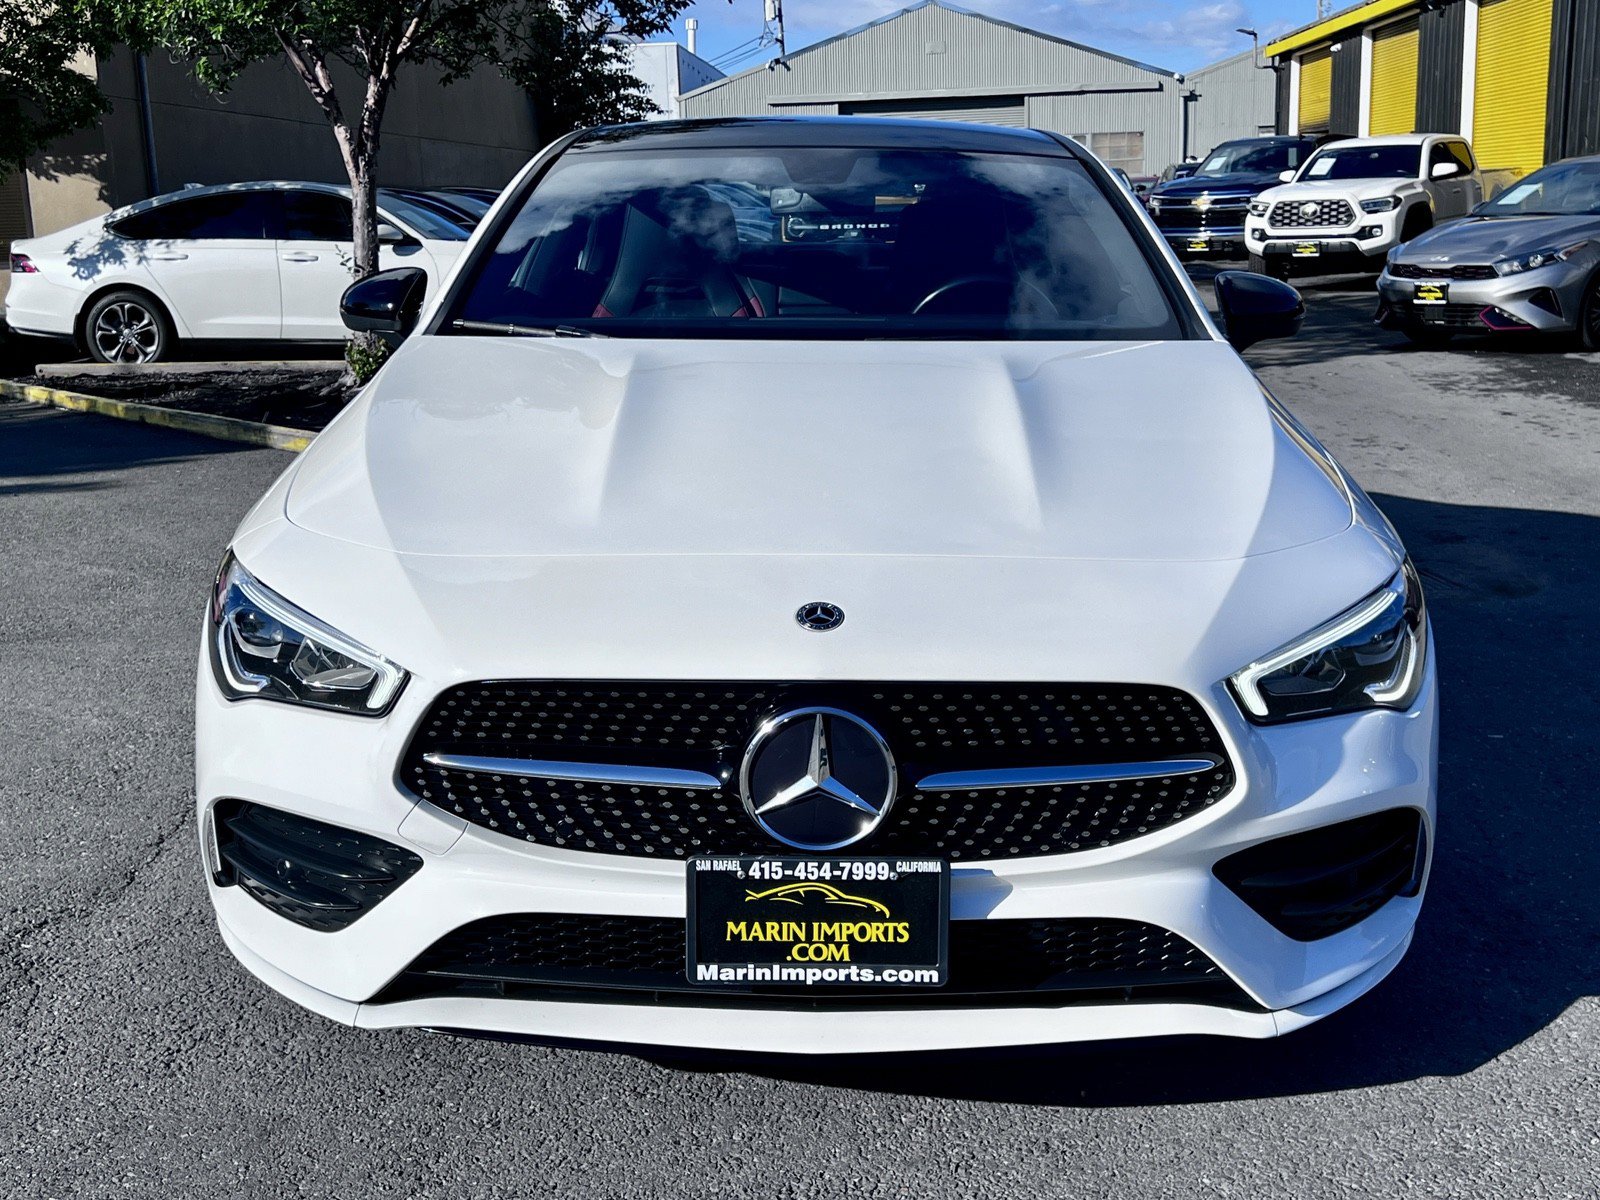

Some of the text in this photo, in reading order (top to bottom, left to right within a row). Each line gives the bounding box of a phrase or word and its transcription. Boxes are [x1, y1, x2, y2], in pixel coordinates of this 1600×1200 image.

[695, 860, 741, 871] SAN RAFAEL
[748, 861, 890, 880] 415-454-7999
[896, 861, 942, 873] CALIFORNIA
[726, 921, 910, 943] MARIN IMPORTS
[786, 943, 851, 962] .COM
[697, 964, 939, 985] MarinImports.com
